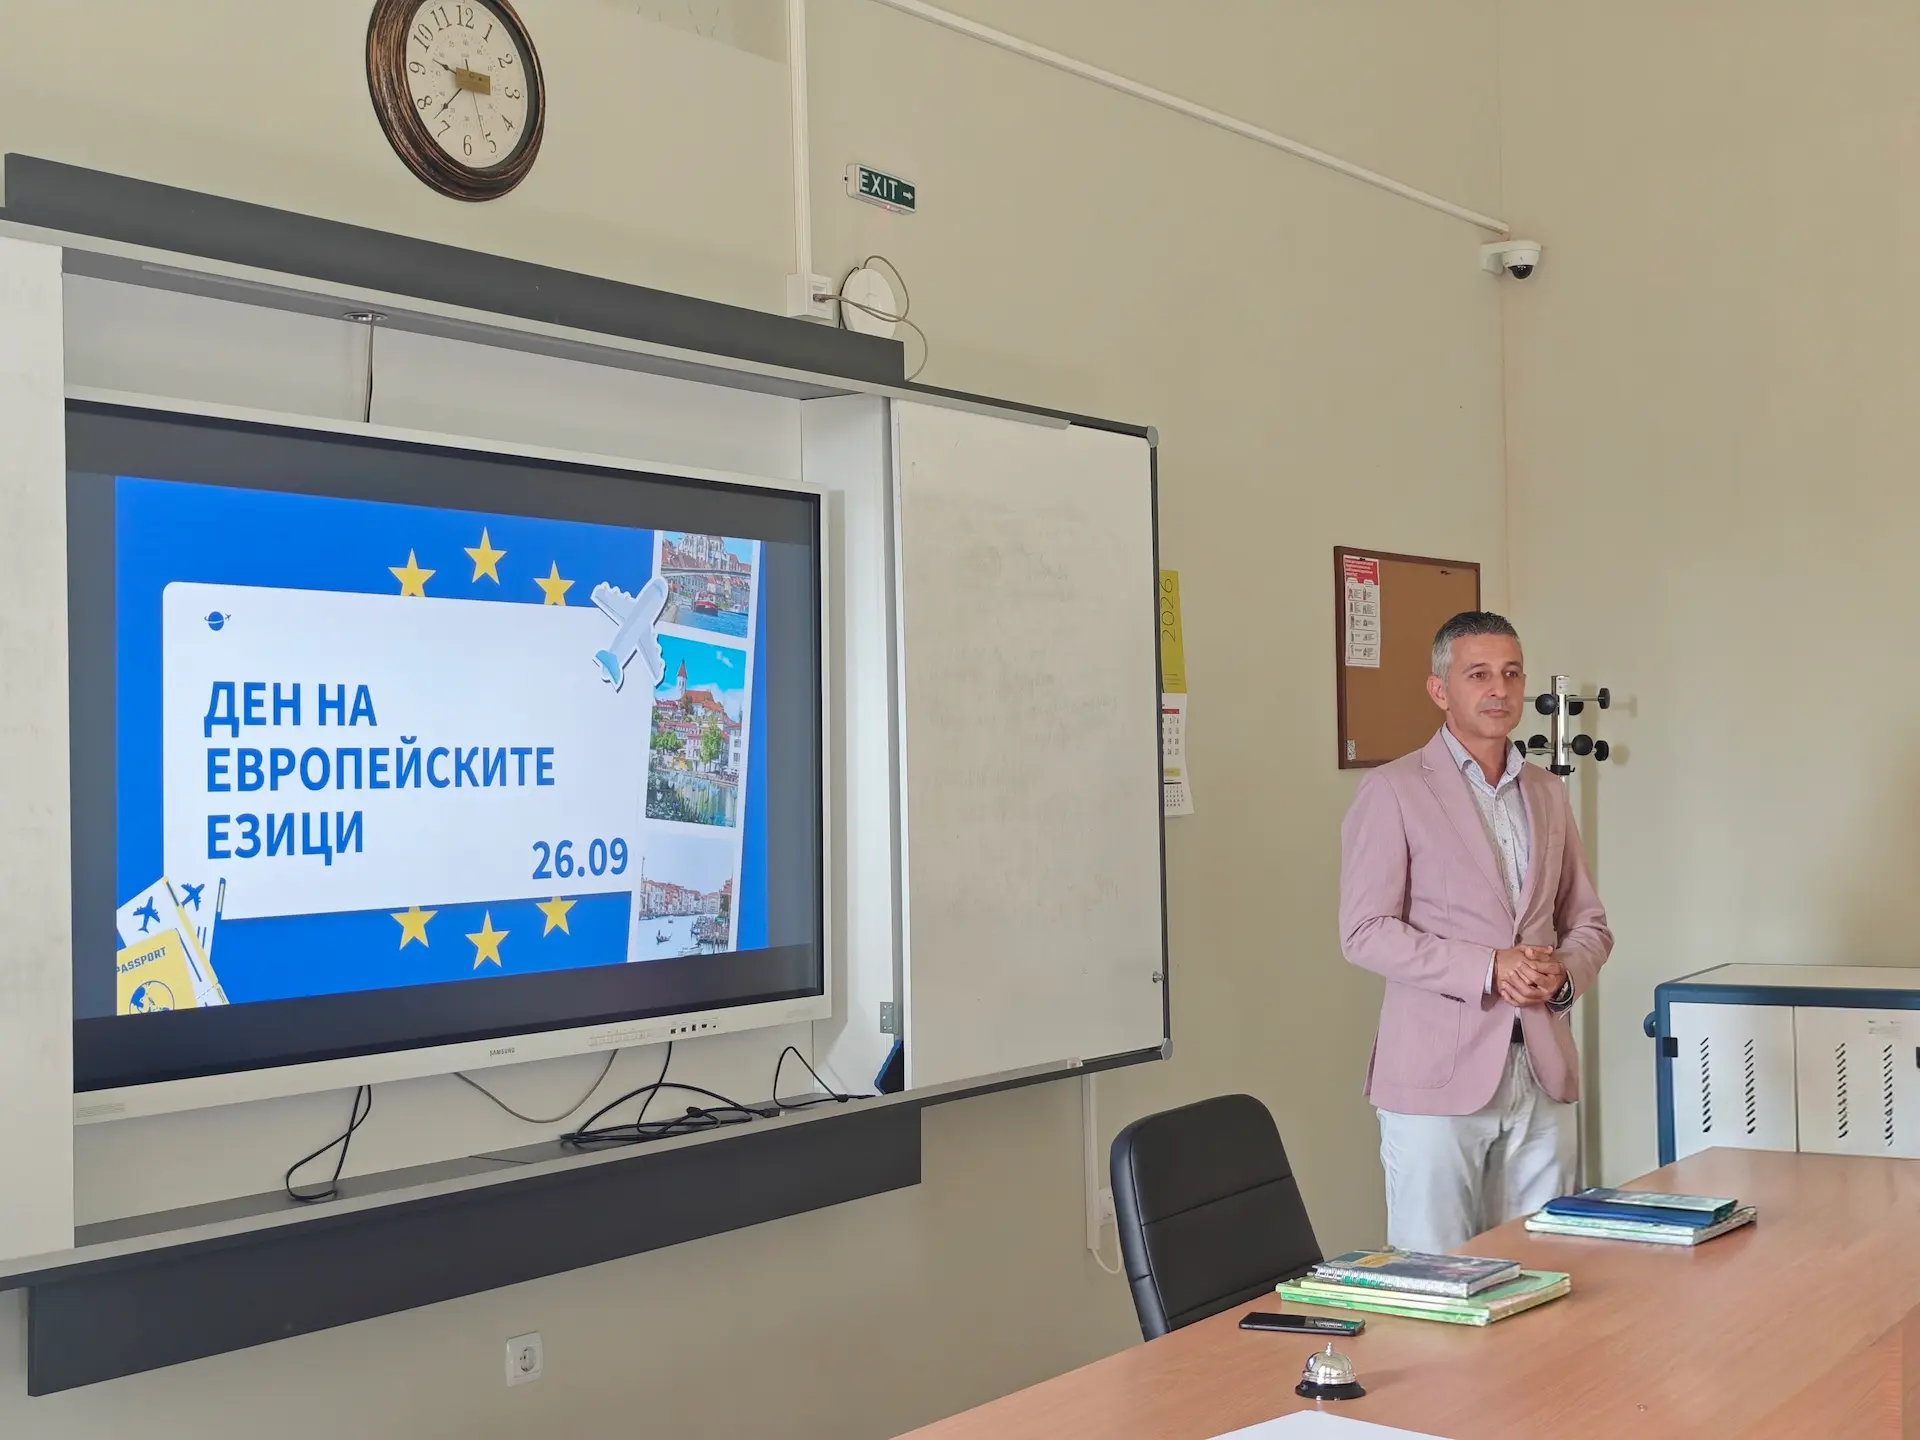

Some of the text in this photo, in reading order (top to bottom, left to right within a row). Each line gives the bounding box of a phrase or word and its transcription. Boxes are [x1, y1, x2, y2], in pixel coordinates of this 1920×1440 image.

[430, 6, 452, 32] 11
[456, 5, 475, 29] 12
[413, 24, 434, 52] 10
[482, 24, 493, 43] 1
[408, 61, 426, 76] 9
[497, 53, 513, 69] 2
[416, 95, 433, 110] 8
[504, 86, 521, 100] 3
[437, 119, 451, 138] 7
[501, 114, 514, 132] 4
[463, 134, 473, 156] 6
[484, 132, 497, 153] 5
[860, 171, 898, 200] EXIT
[1160, 578, 1176, 642] 2026
[203, 681, 377, 738] ДЕН НА
[206, 735, 555, 793] ЕВРОПЕЙСКИТЕ
[206, 810, 364, 867] ЕЗИЦИ
[532, 837, 628, 880] 26.09
